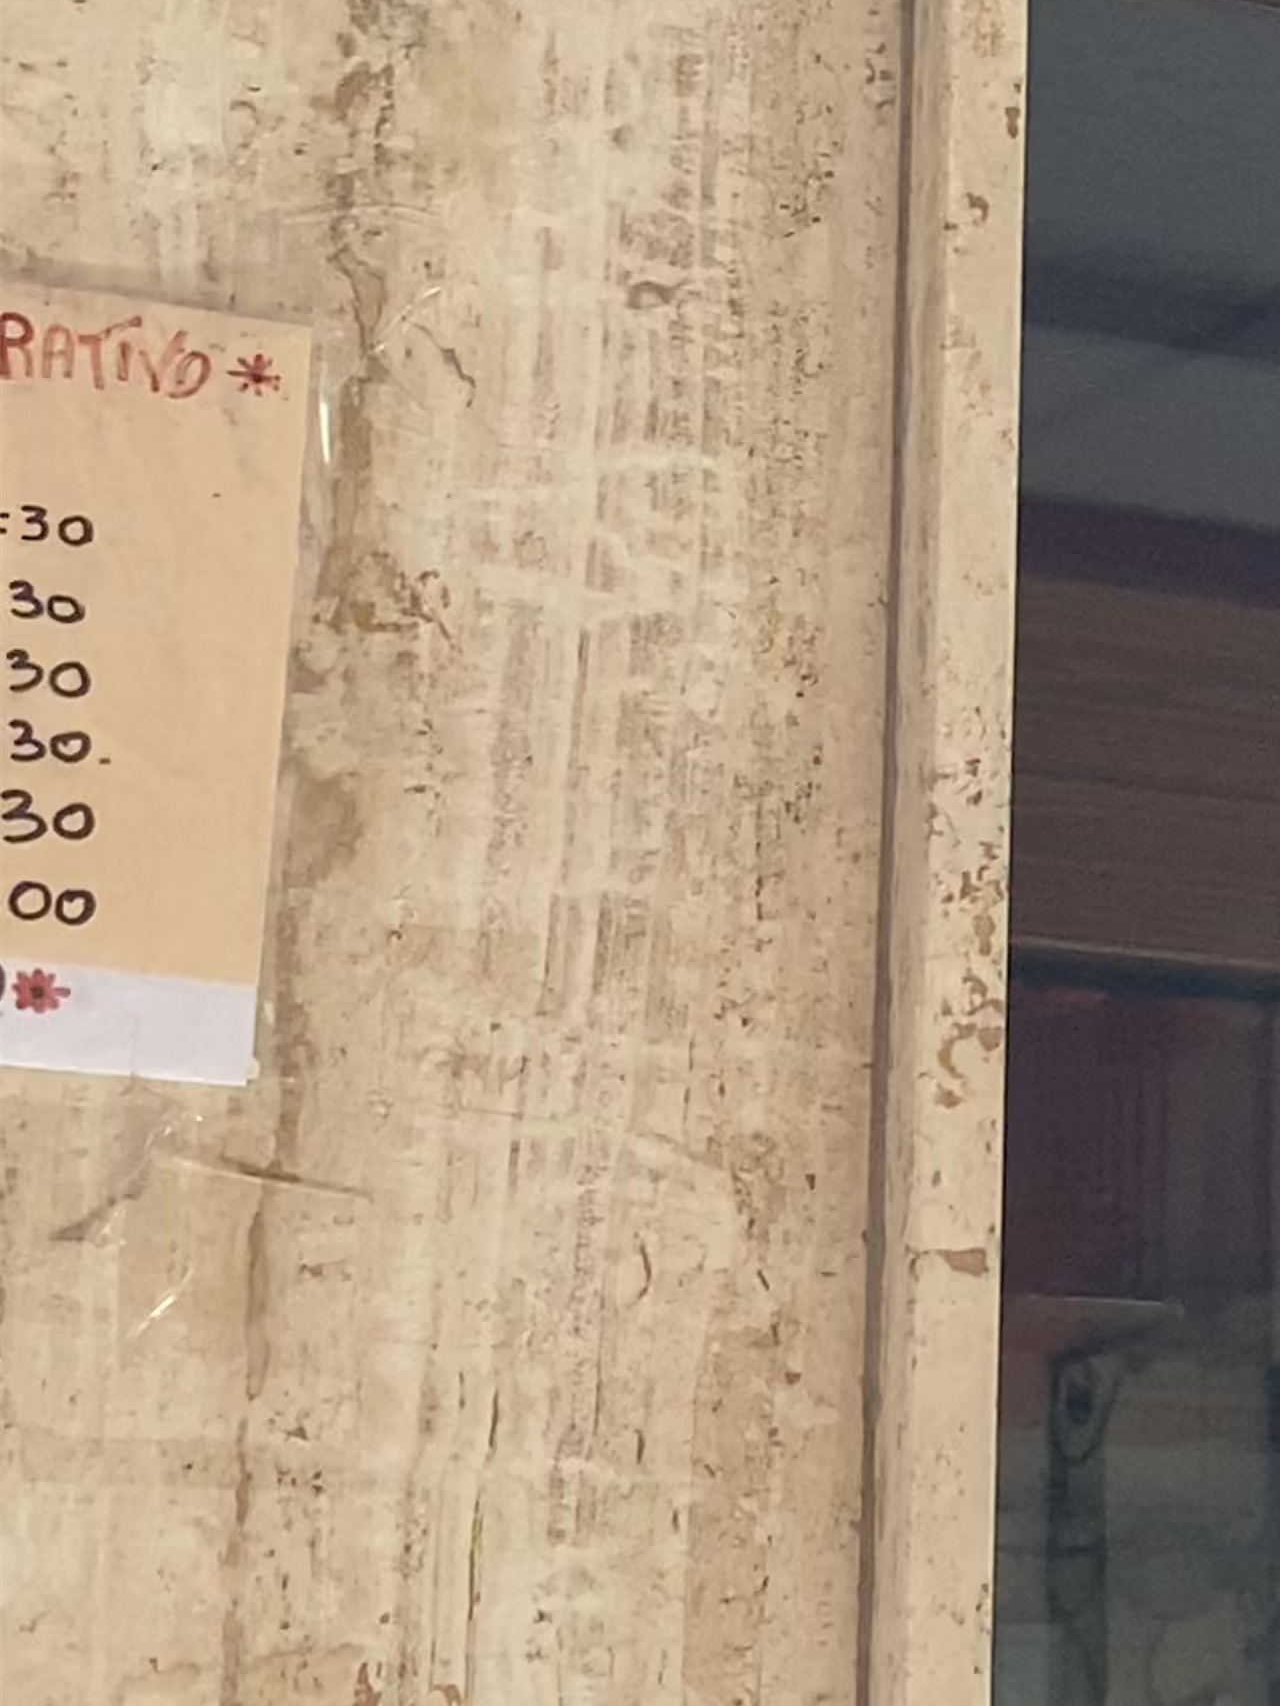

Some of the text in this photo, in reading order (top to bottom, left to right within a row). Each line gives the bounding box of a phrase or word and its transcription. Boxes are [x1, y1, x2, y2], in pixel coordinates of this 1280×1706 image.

[9, 580, 86, 624] 30
[6, 649, 91, 699] 30
[0, 789, 96, 844] 30
